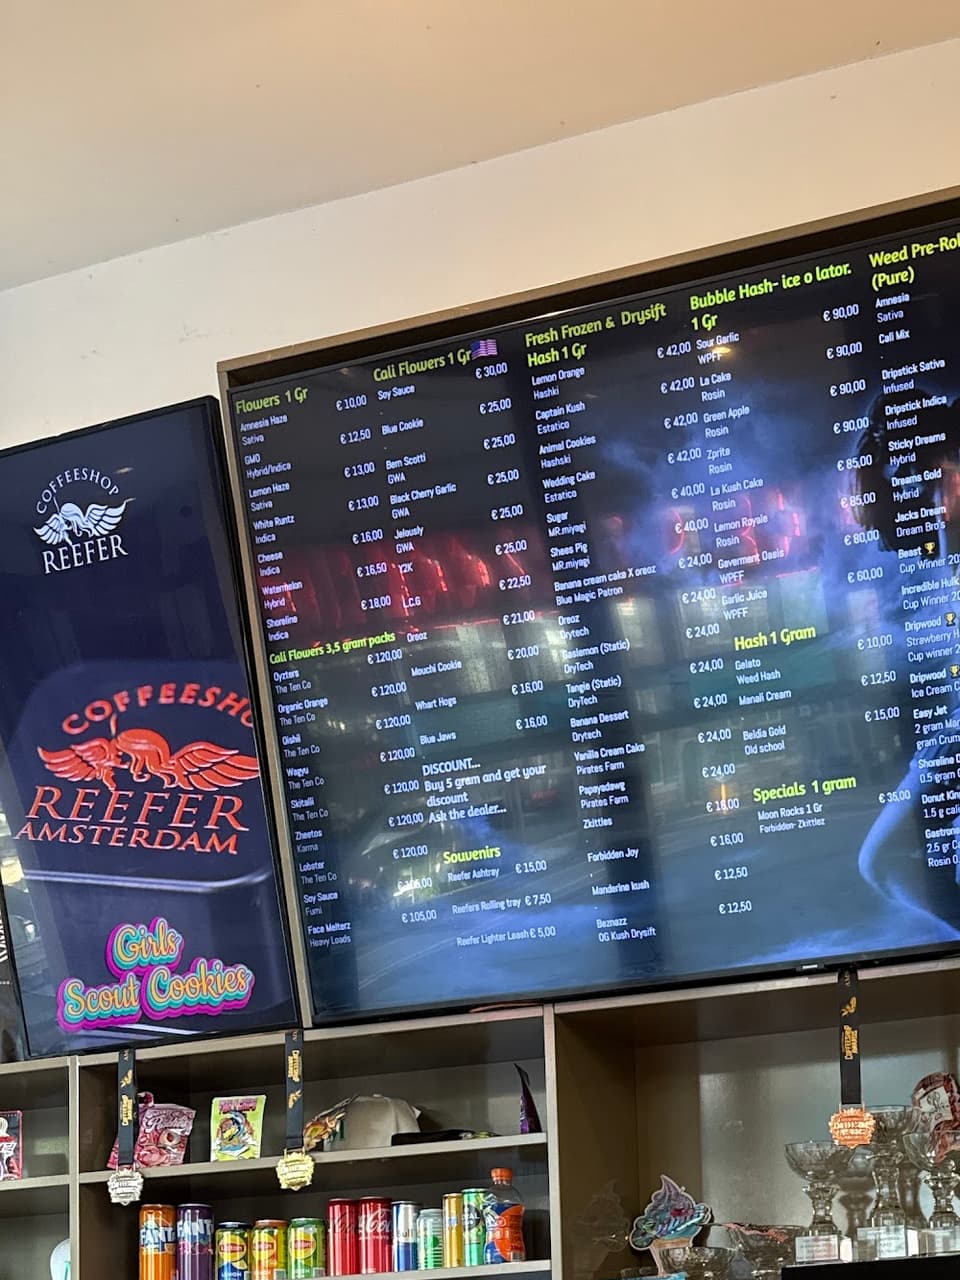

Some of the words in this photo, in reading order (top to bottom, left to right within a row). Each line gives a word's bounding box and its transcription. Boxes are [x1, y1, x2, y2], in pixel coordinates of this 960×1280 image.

[869, 245, 908, 267] Weed
[690, 289, 736, 310] Bubble
[739, 280, 779, 299] Hash-
[782, 274, 801, 289] ice
[815, 263, 852, 280] lator.
[872, 266, 915, 291] (Pure)
[525, 329, 558, 348] Fresh
[561, 320, 602, 339] Frozen
[605, 316, 615, 329] &
[621, 304, 666, 326] Drysift
[692, 317, 698, 330] 1
[702, 313, 718, 331] Gr
[373, 361, 396, 381] Cali
[399, 353, 445, 378] Flowers
[448, 353, 454, 366] 1
[457, 349, 471, 364] Gr
[527, 348, 559, 367] Hash
[562, 346, 568, 360] 1
[572, 342, 587, 358] Gr
[236, 393, 280, 414] Flowers
[286, 390, 292, 403] 1
[295, 388, 308, 403] Gr
[703, 411, 726, 423] Green
[727, 405, 750, 419] Apple
[36, 467, 119, 514] COFFEESHOP
[410, 487, 434, 503] Cherry
[42, 534, 128, 575] REEFER
[270, 653, 286, 665] Cali
[288, 643, 324, 661] Flowers
[343, 638, 366, 653] gram
[368, 632, 396, 649] packs
[734, 635, 767, 650] Hash
[770, 632, 777, 644] 1
[781, 626, 816, 643] Gram
[907, 631, 951, 647] Strawberry
[745, 745, 757, 755] Old
[759, 741, 785, 752] school
[424, 779, 444, 793] Buy
[446, 776, 452, 788] 5
[455, 774, 480, 790] gram
[483, 770, 501, 783] and
[503, 767, 521, 783] get
[523, 765, 546, 781] your
[753, 783, 806, 803] Specials
[811, 780, 818, 793] 1
[822, 776, 857, 795] gram
[25, 785, 249, 831] REEFER
[427, 792, 469, 807] discount
[429, 810, 447, 824] Ask
[449, 806, 465, 820] the
[13, 821, 238, 854] AMSTERDAM
[443, 845, 500, 865] Souvenirs
[109, 919, 183, 968] Girls
[60, 972, 140, 1021] Scout
[146, 958, 252, 1008] Cookies
